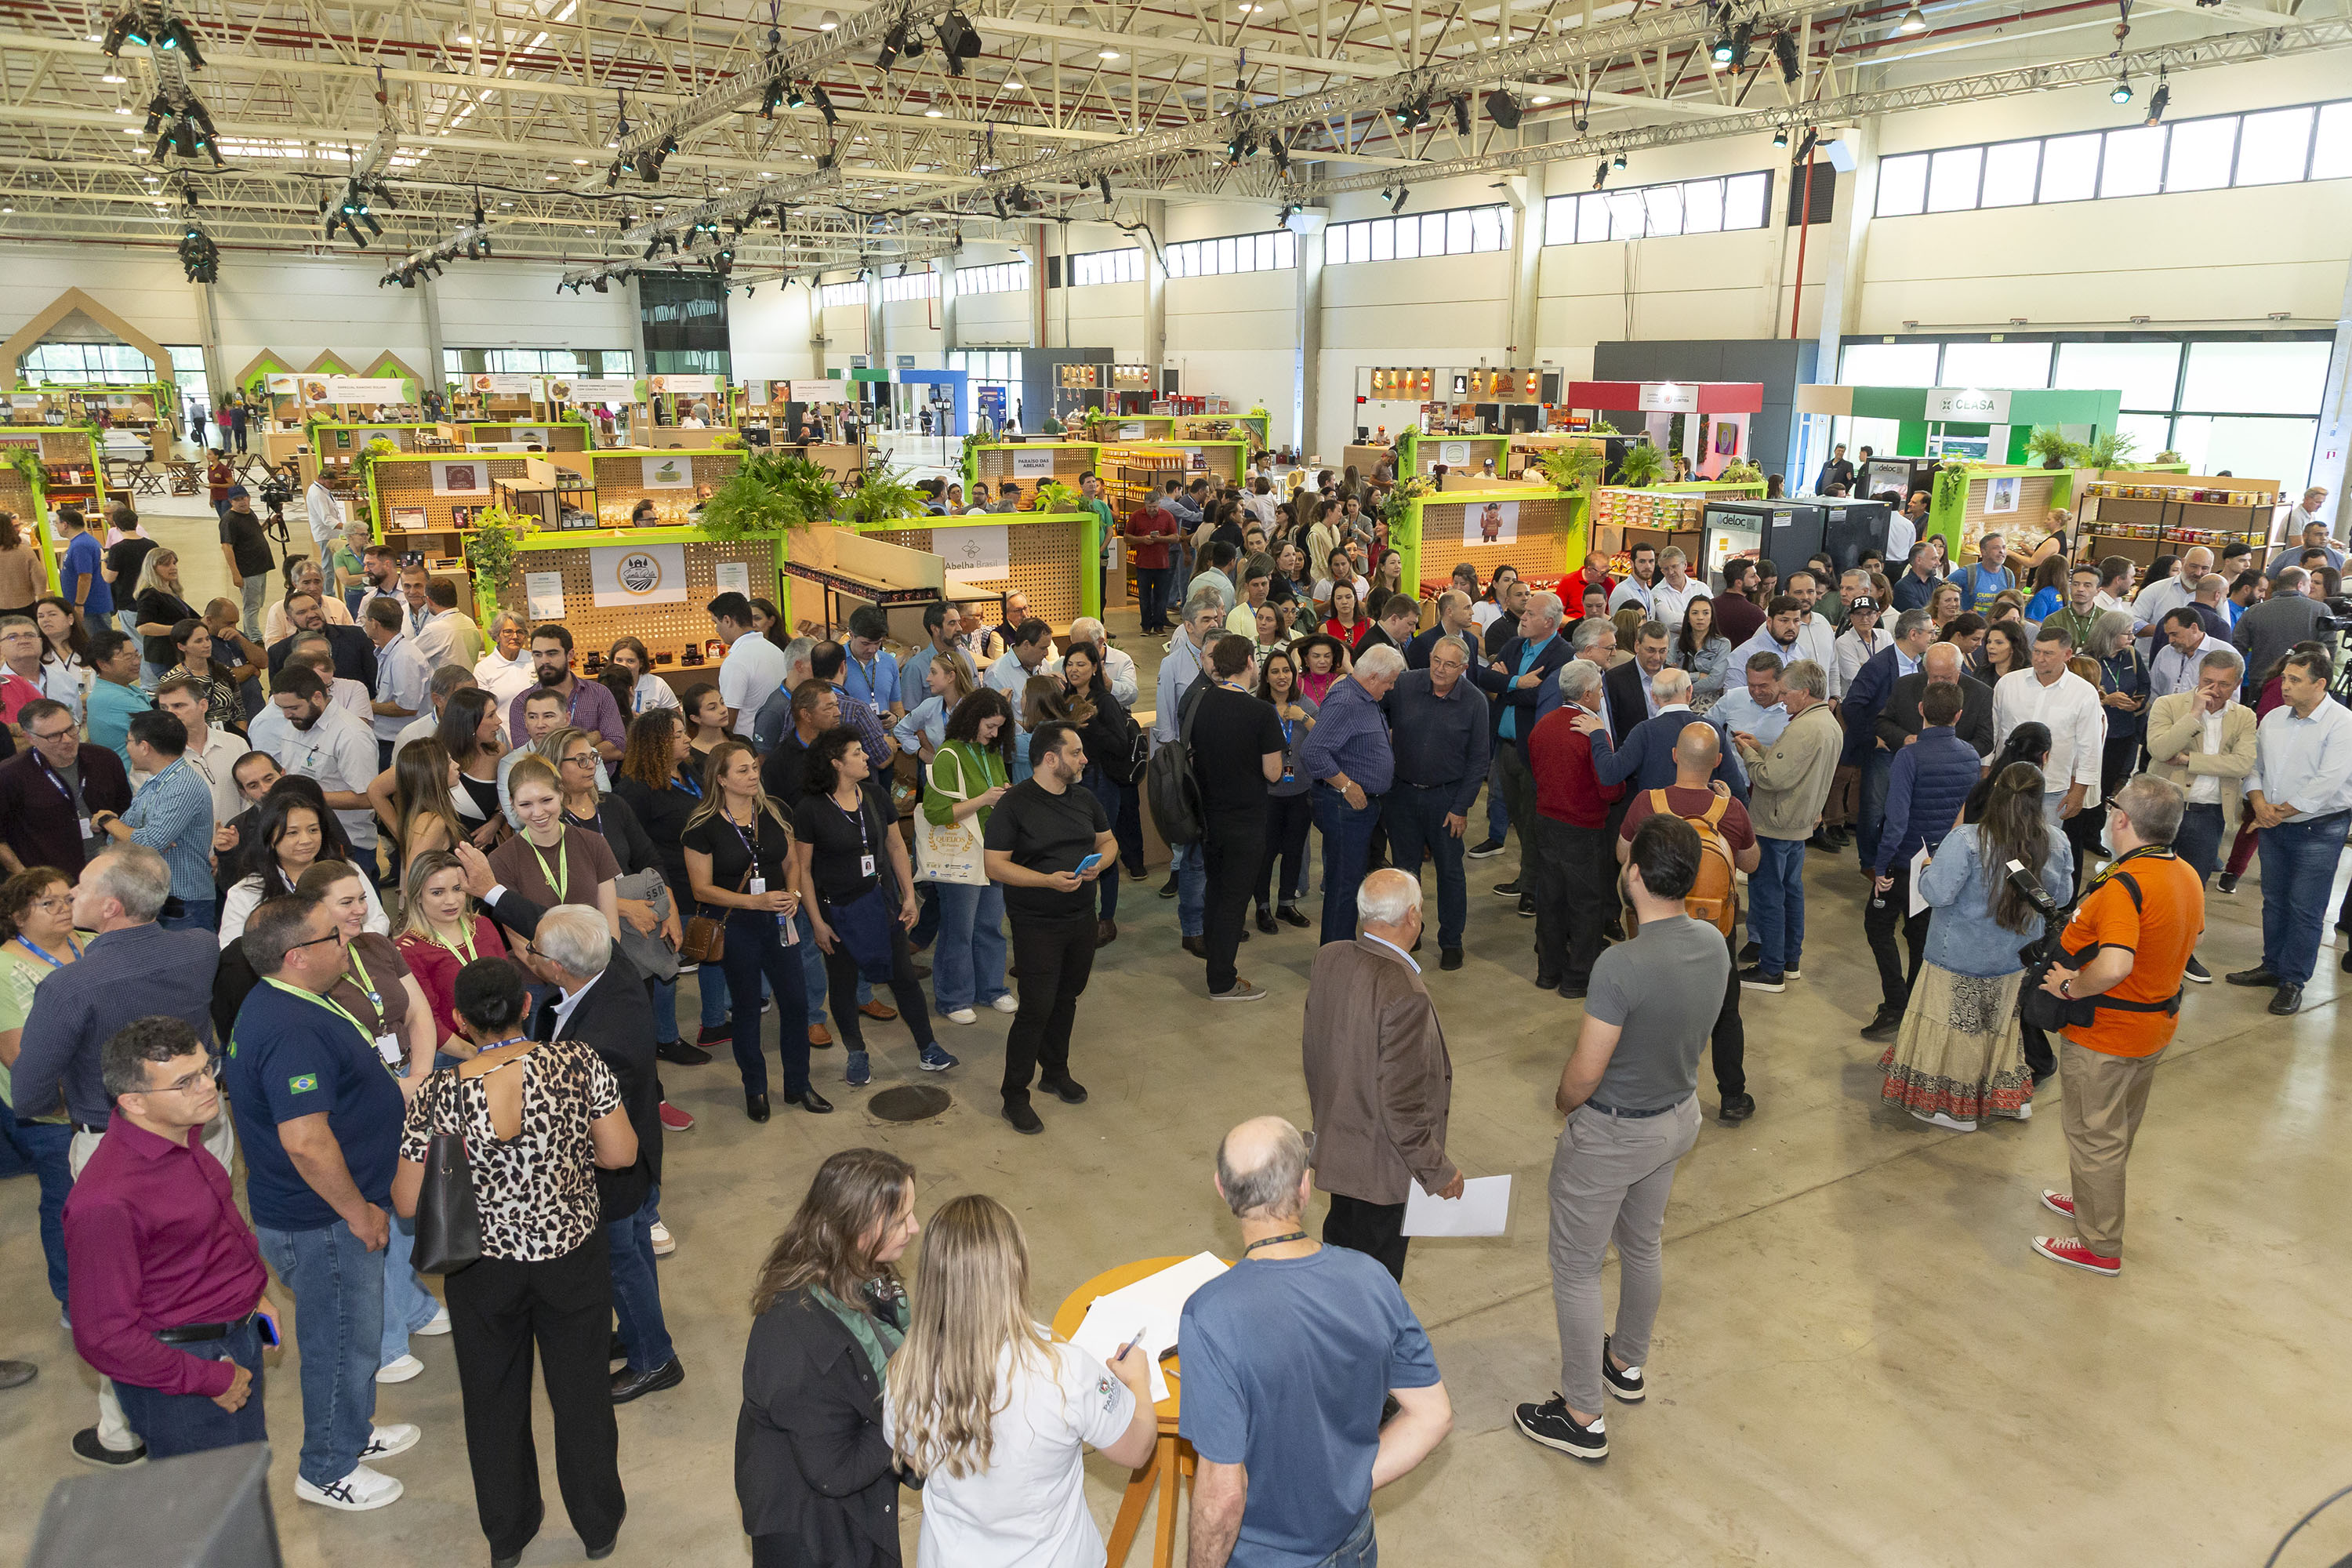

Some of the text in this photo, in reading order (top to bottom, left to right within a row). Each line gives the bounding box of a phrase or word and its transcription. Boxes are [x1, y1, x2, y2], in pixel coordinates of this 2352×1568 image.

[1955, 399, 1994, 411] CEASA
[1878, 463, 1896, 472] deloc
[1722, 514, 1746, 527] deloc
[946, 559, 998, 570] Abelha Brasil
[1854, 597, 1870, 608] PR
[1103, 1374, 1116, 1411] PARANÁ
